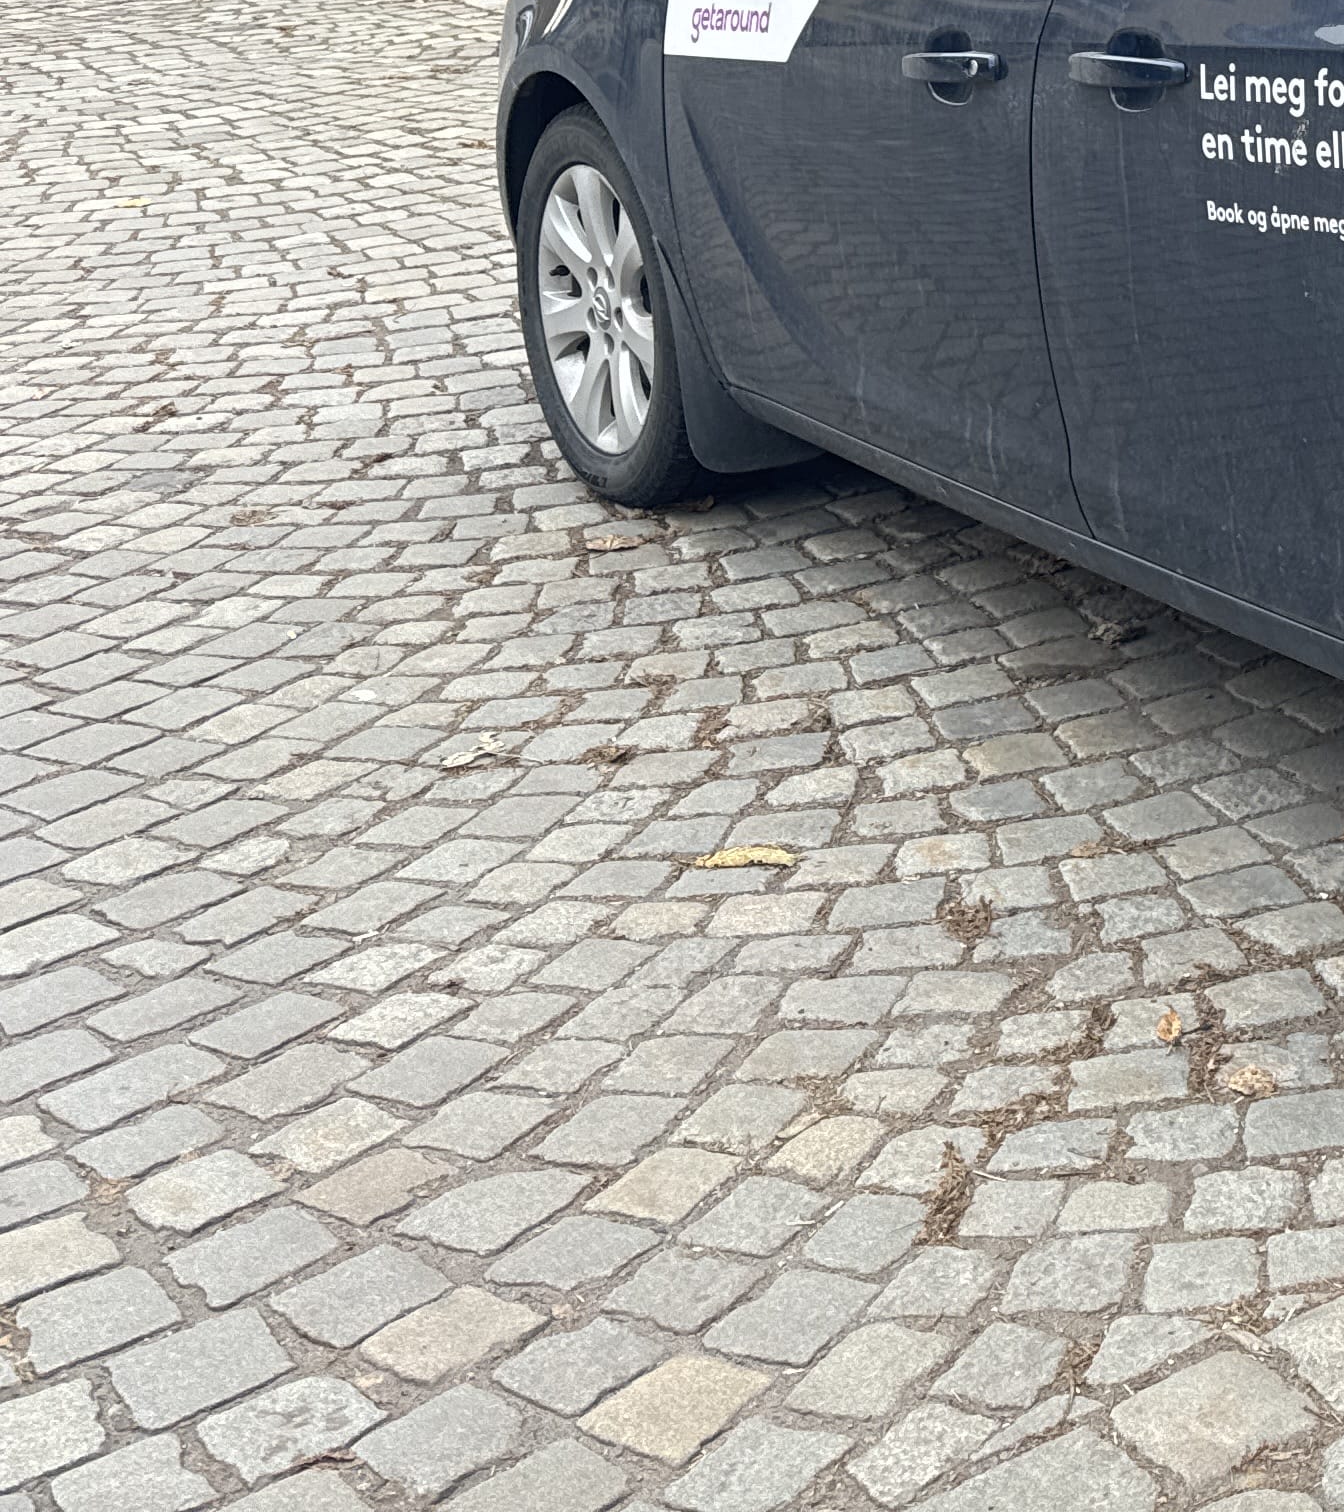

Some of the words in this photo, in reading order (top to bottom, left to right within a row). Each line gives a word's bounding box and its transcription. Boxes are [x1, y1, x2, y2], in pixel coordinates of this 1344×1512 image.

[690, 1, 773, 43] getaround
[1200, 63, 1236, 101] Lei
[1245, 75, 1306, 117] meg
[1202, 133, 1234, 161] en
[1241, 124, 1308, 167] time
[1206, 200, 1245, 224] Book
[1247, 209, 1267, 232] og
[1270, 205, 1310, 235] åpne
